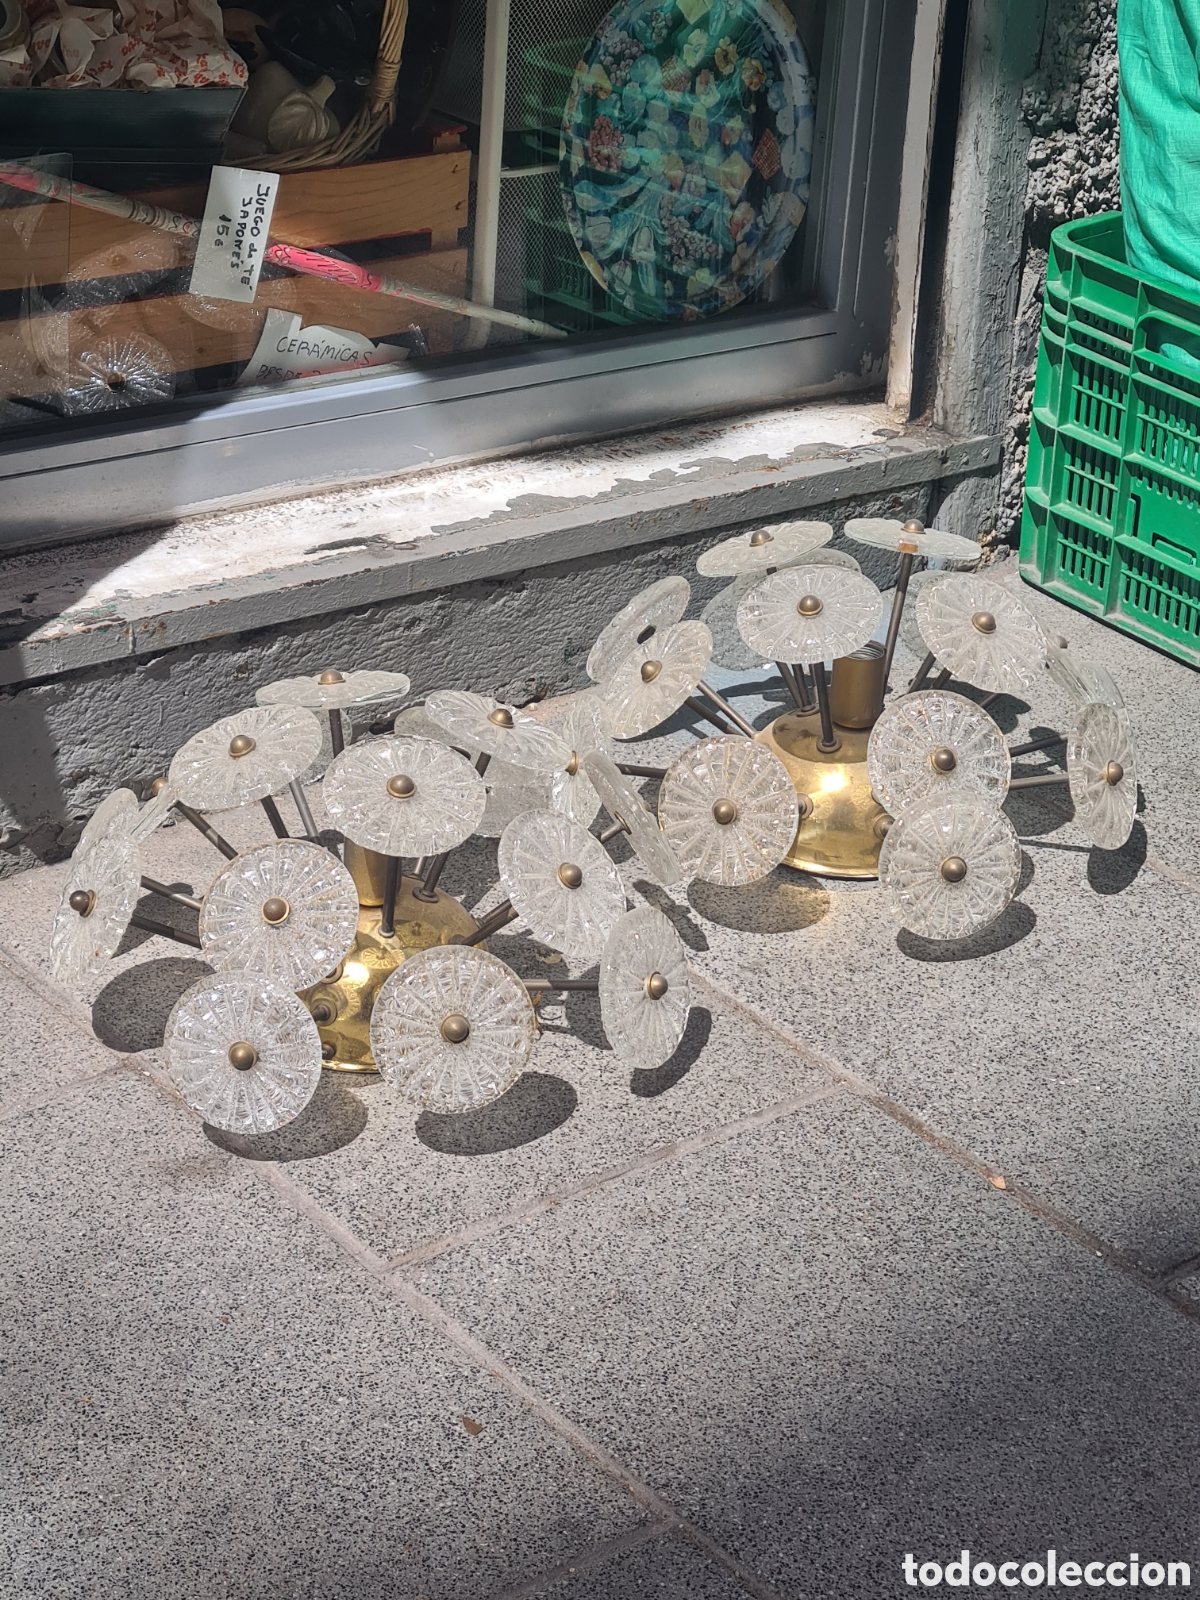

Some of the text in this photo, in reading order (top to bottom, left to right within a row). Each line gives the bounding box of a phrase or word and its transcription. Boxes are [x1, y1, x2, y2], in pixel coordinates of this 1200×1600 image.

[230, 196, 253, 269] JAPONÉS
[250, 183, 270, 237] JUEGO
[276, 336, 372, 366] CERÁMICAS
